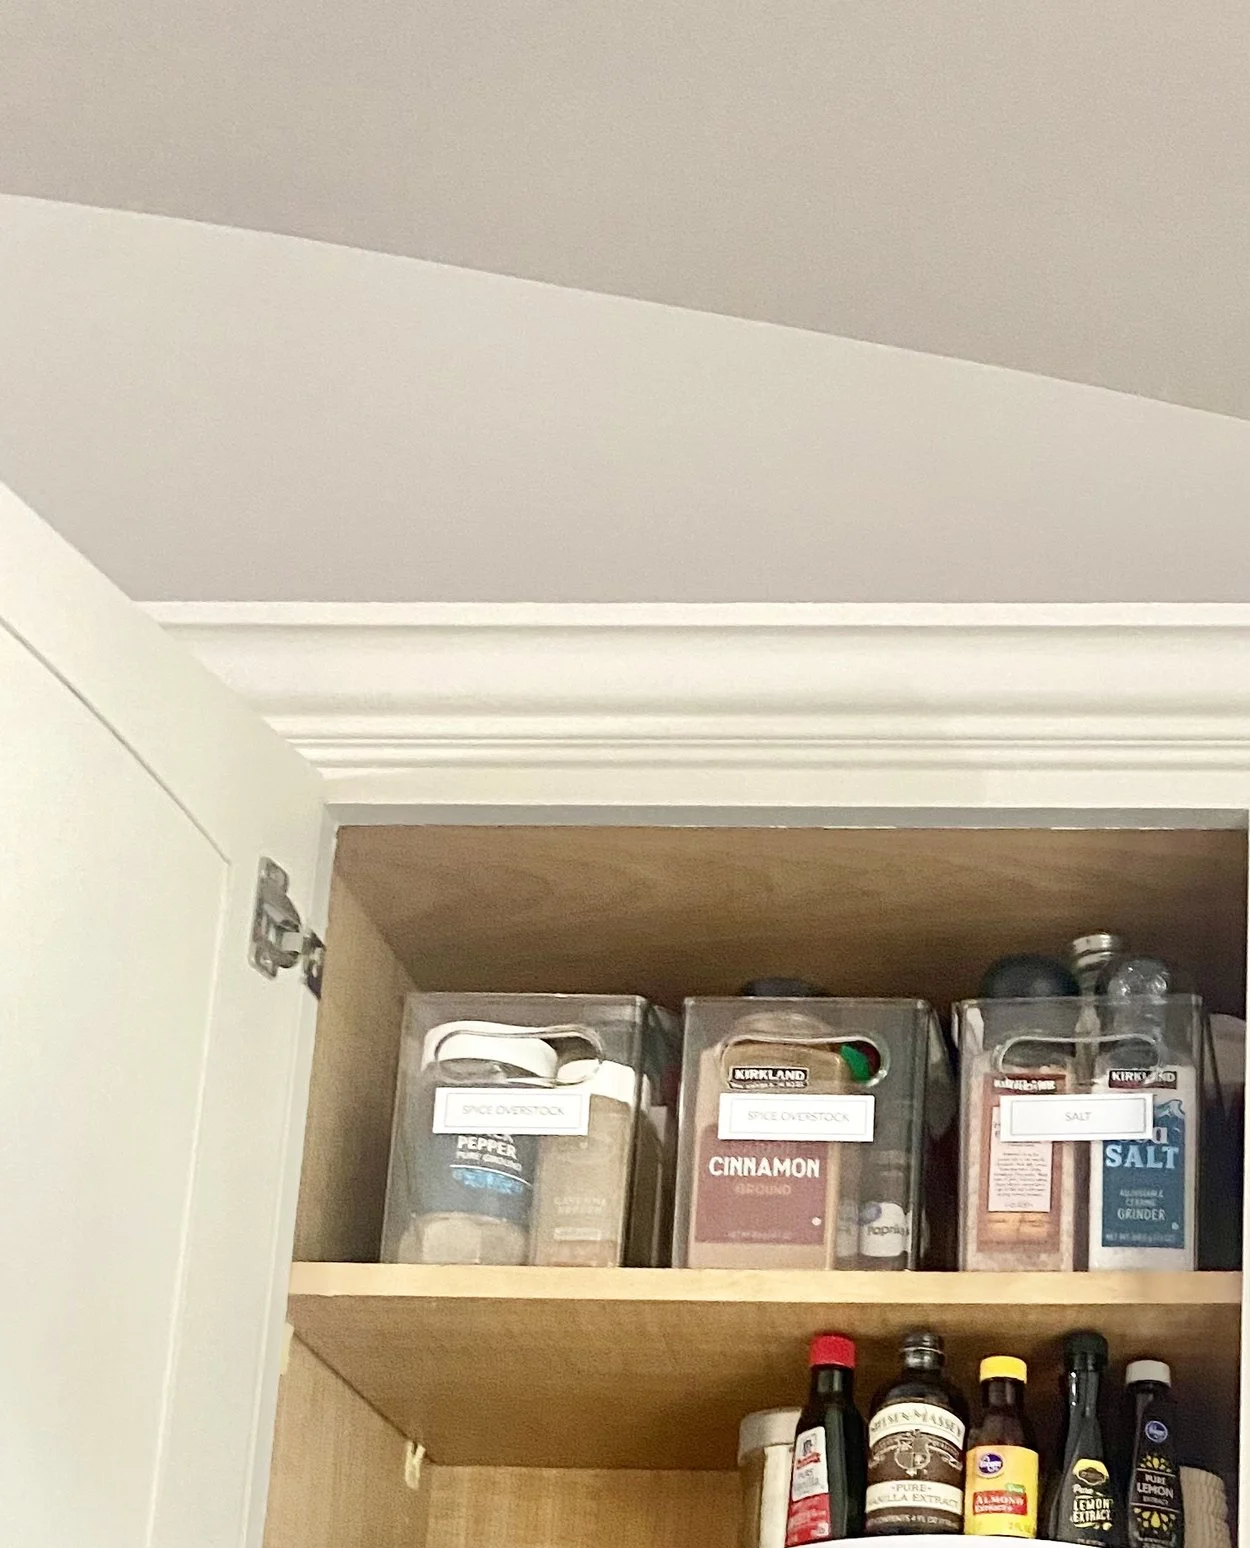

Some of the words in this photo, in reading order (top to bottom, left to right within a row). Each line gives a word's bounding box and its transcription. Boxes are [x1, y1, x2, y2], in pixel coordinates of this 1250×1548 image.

[734, 1069, 806, 1082] KIRKLAND
[462, 1104, 494, 1115] SPICE
[496, 1105, 566, 1117] OVERSTOCK
[747, 1111, 777, 1122] SPICE
[780, 1112, 850, 1123] OVERSTOCK
[1065, 1111, 1092, 1122] SALT
[457, 1135, 518, 1160] PEPPER
[1105, 1145, 1179, 1170] SALT
[708, 1156, 820, 1179] CINNAMON
[735, 1183, 791, 1196] GROUND
[1117, 1208, 1166, 1221] GRINDER
[895, 1484, 928, 1492] PURE
[1136, 1483, 1174, 1499] LEMON
[912, 1494, 958, 1506] EXTRACT
[1073, 1499, 1110, 1511] LEMON
[1071, 1511, 1111, 1523] EXTRACT
